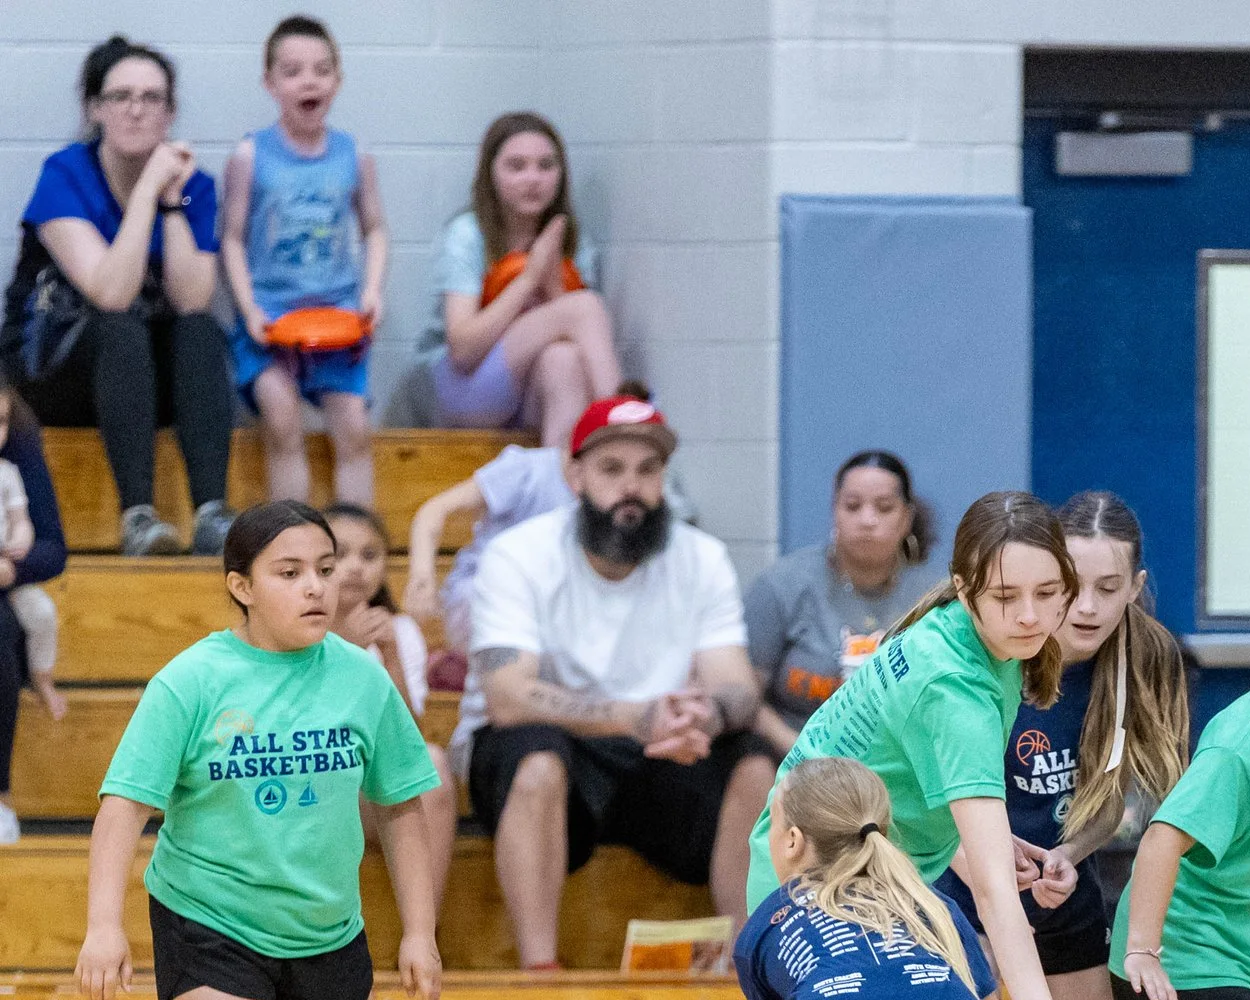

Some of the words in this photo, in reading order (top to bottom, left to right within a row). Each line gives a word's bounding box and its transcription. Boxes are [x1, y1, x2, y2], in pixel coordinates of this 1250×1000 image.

[229, 733, 284, 756] ALL
[292, 727, 356, 752] STAR
[1031, 748, 1077, 776] ALL
